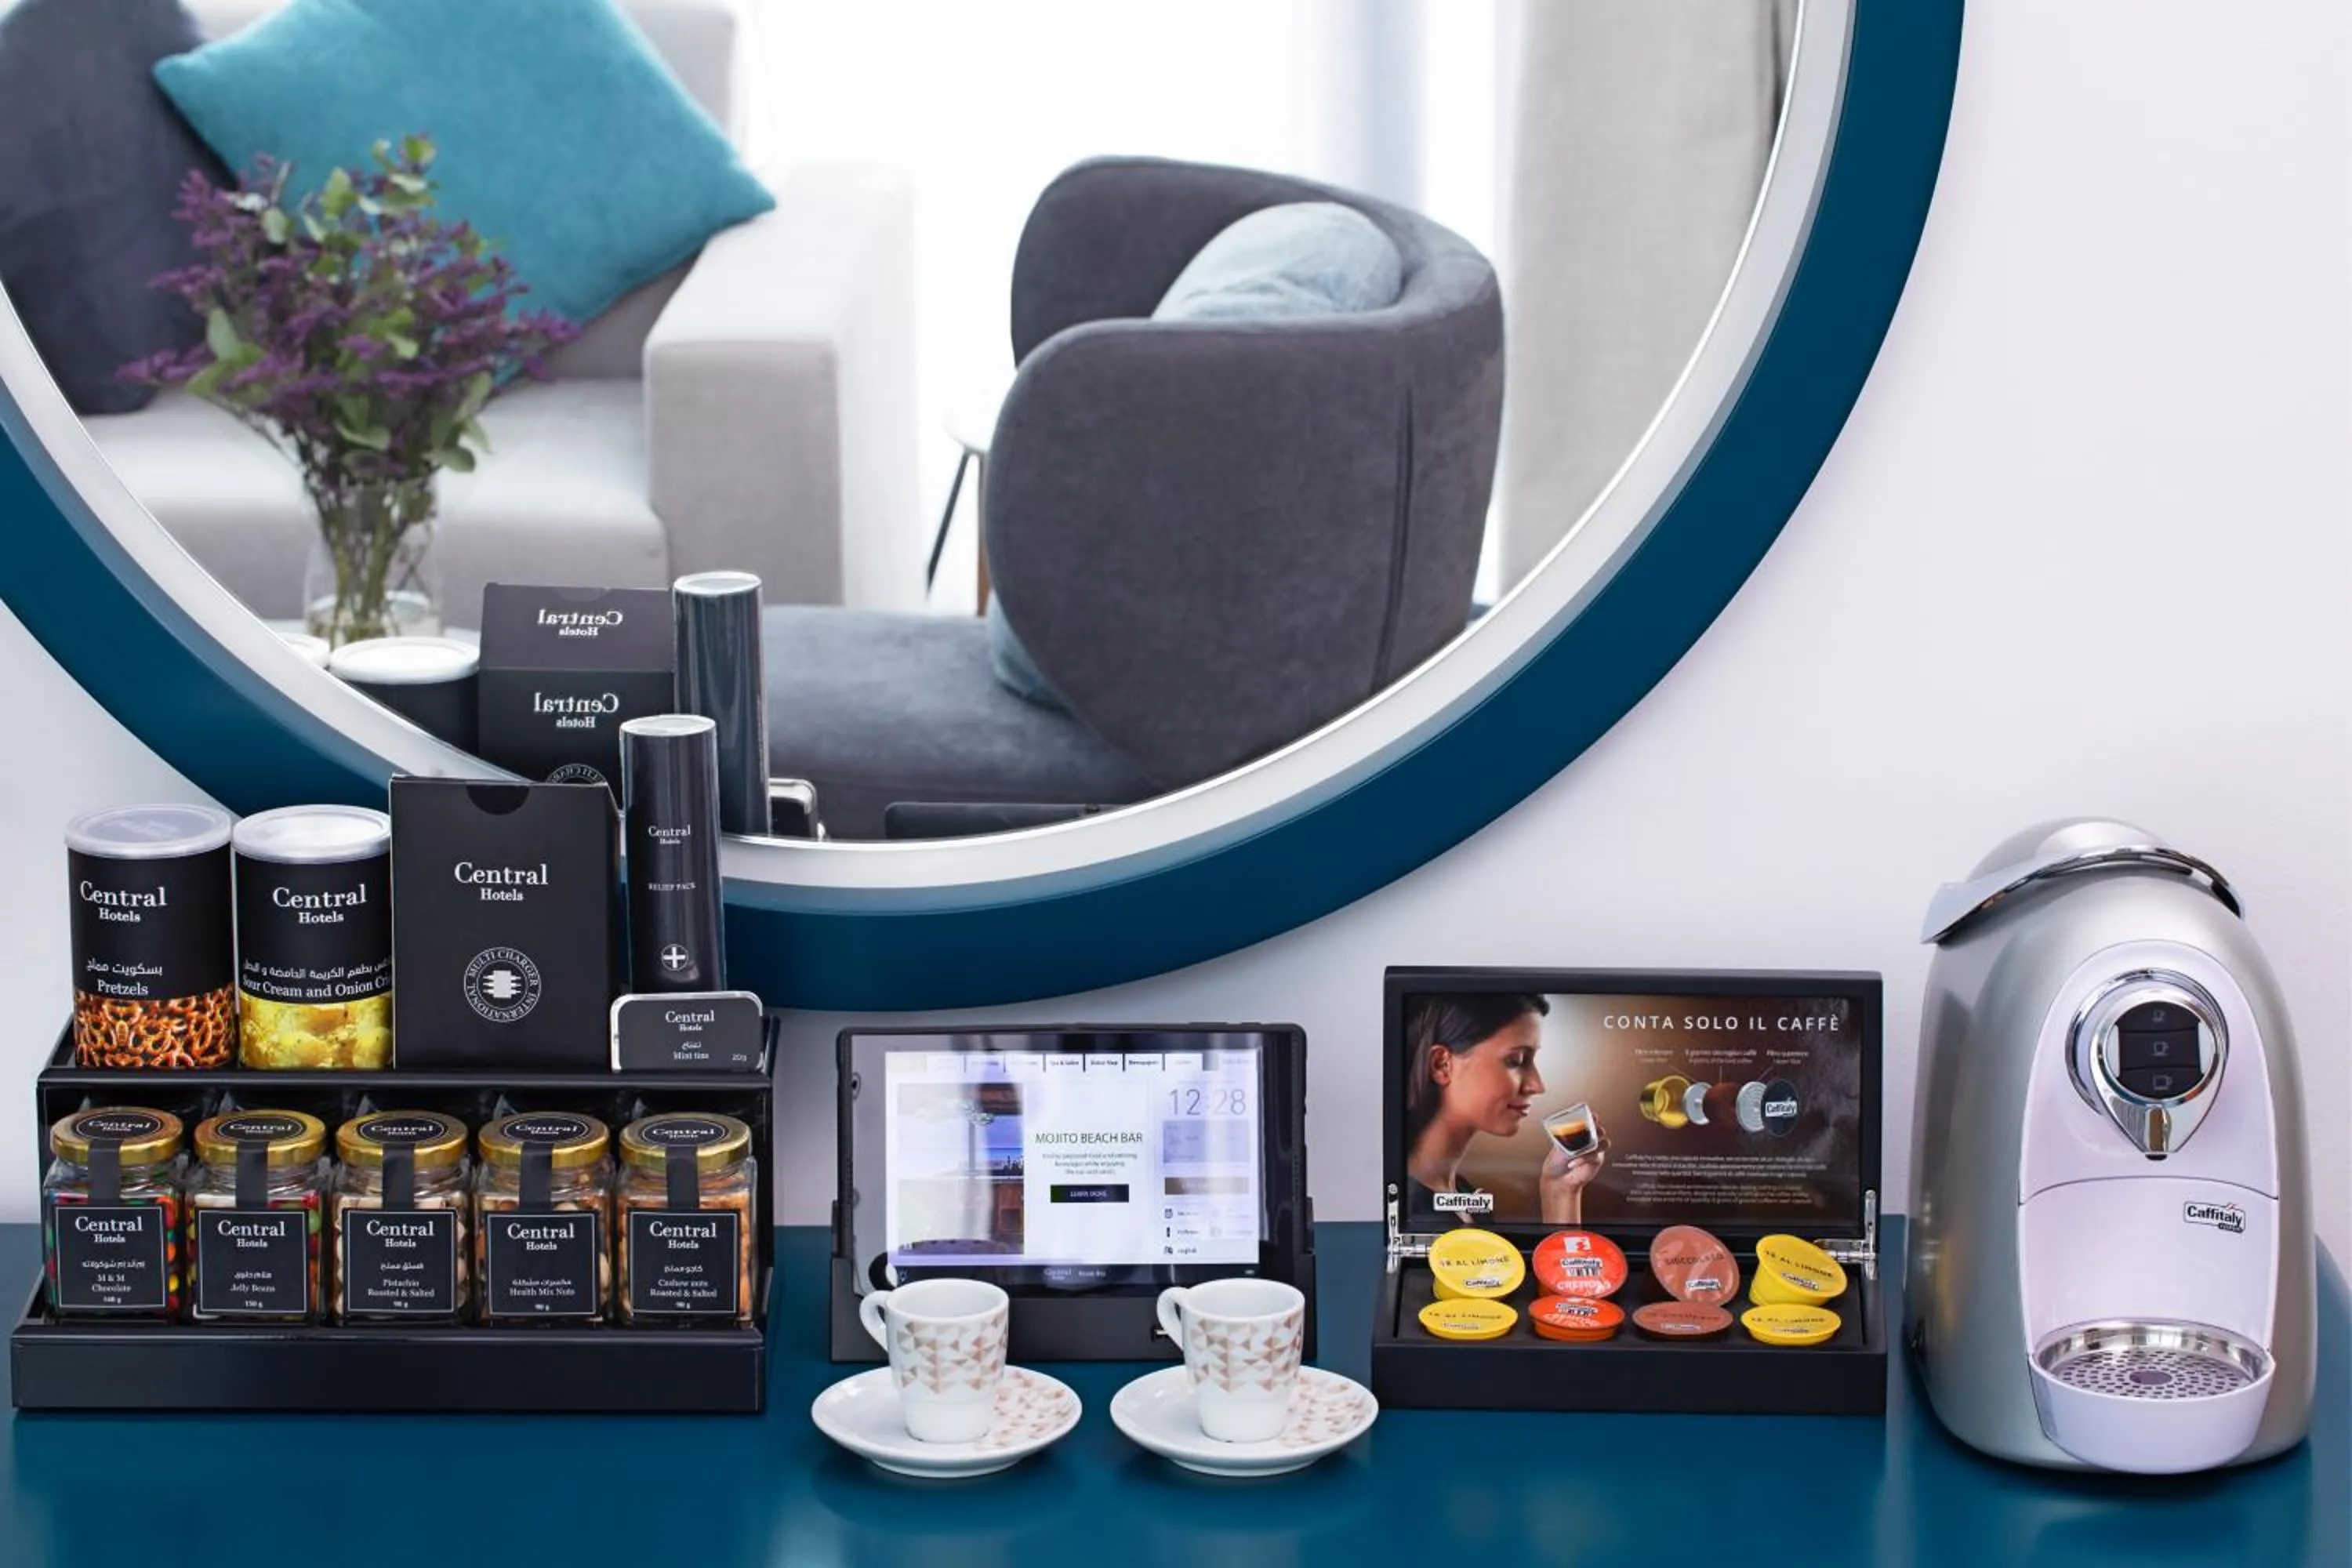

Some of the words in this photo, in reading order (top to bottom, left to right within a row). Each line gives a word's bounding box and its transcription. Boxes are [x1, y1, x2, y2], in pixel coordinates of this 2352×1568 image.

[648, 824, 691, 837] Central
[454, 862, 549, 885] Central
[80, 880, 168, 907] Central
[272, 883, 367, 908] Central
[480, 887, 524, 901] Hotels
[99, 907, 141, 923] Hotels
[298, 910, 344, 924] Hotels
[112, 963, 163, 977] بسكويت
[310, 967, 344, 980] الكريمة
[468, 951, 495, 977] MULTI
[497, 949, 539, 987] CHARGER
[96, 978, 149, 996] Pretzels
[263, 981, 303, 997] Cream
[306, 985, 332, 998] and
[335, 979, 373, 996] Onion
[665, 1009, 715, 1023] Central
[1603, 1015, 1675, 1029] CONTA
[1684, 1016, 1738, 1030] SOLO
[1749, 1017, 1766, 1030] IL
[1777, 1014, 1839, 1032] CAFFÈ
[1035, 1133, 1078, 1144] MOJITO
[1081, 1133, 1118, 1144] BEACH
[1120, 1132, 1143, 1144] BAR
[1436, 1196, 1490, 1209] Caffitaly
[2187, 1205, 2242, 1227] Caffitaly
[74, 1216, 143, 1232] Central
[218, 1219, 286, 1236] Central
[366, 1219, 434, 1236] Central
[507, 1222, 575, 1239] Central
[650, 1221, 717, 1238] Central
[94, 1233, 125, 1243] Hotels
[237, 1239, 268, 1247] Hotels
[385, 1239, 416, 1247] Hotels
[526, 1241, 557, 1250] Hotels
[668, 1240, 699, 1249] Hotels
[92, 1283, 132, 1293] Chocolate
